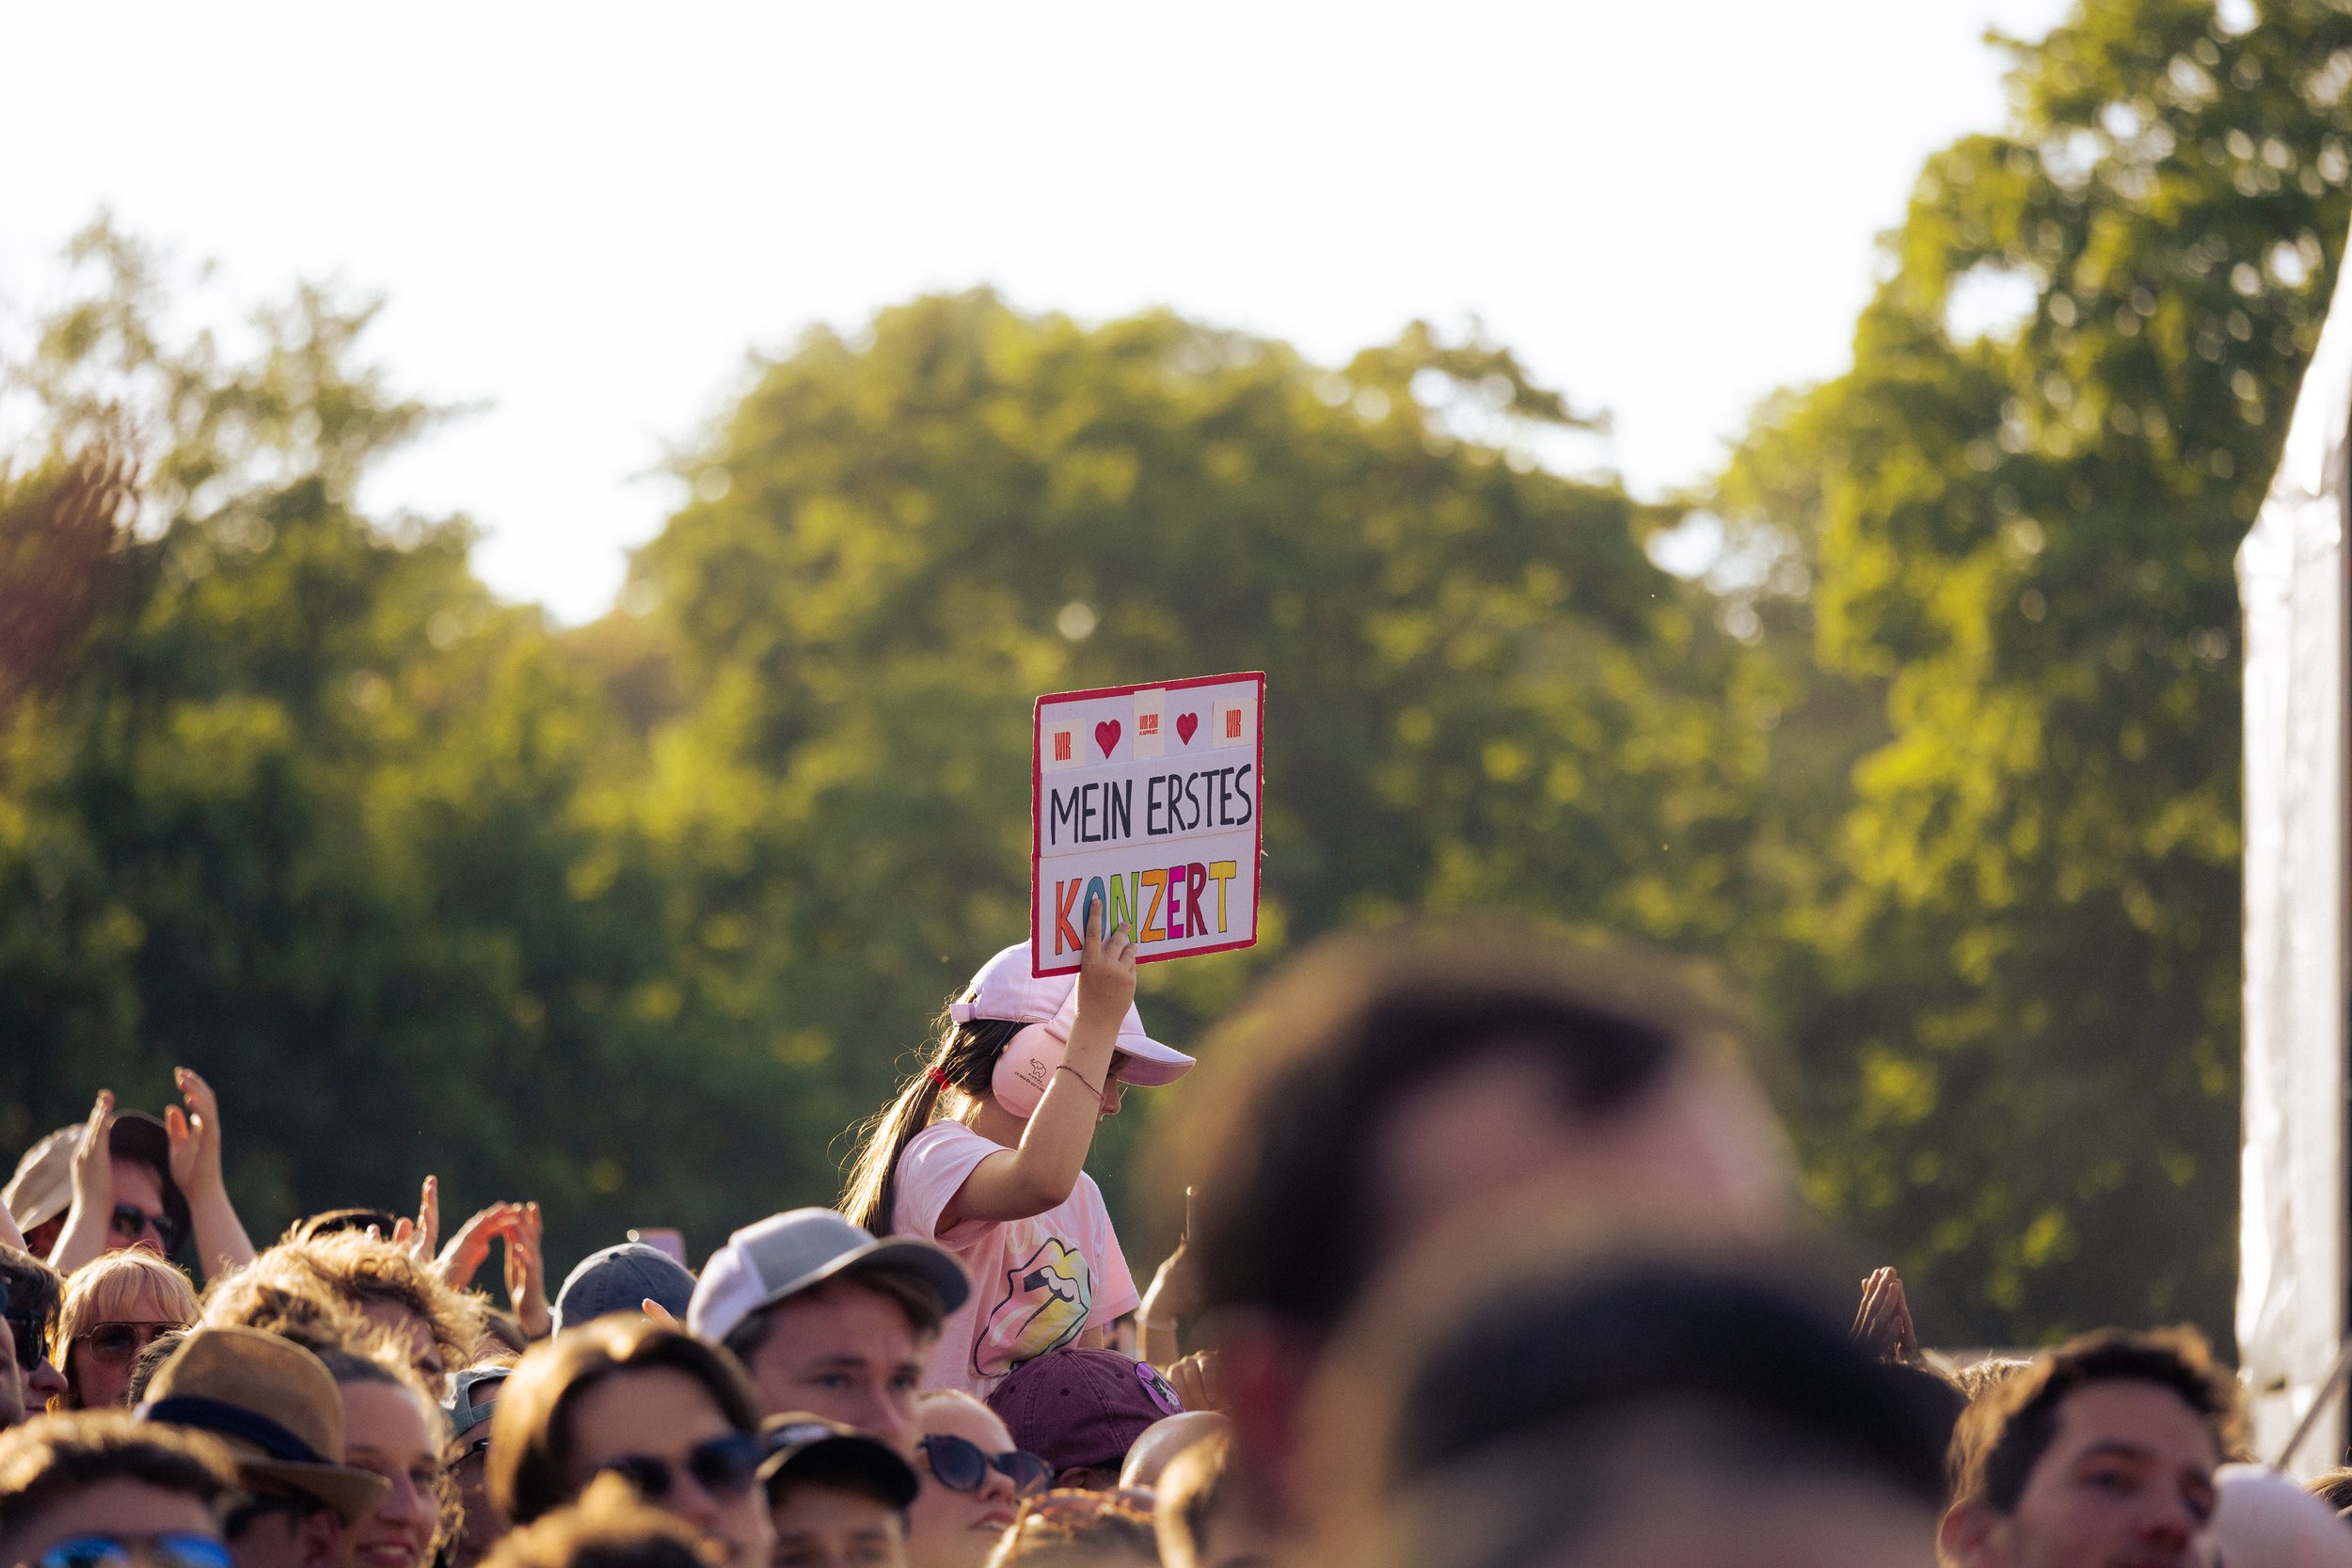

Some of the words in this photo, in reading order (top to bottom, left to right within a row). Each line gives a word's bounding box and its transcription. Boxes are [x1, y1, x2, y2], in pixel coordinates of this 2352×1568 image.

[1054, 731, 1072, 762] WIR
[1226, 708, 1242, 738] WIR
[1051, 779, 1132, 845] MEIN
[1147, 763, 1252, 836] ERSTES
[1055, 861, 1236, 955] KONZERT
